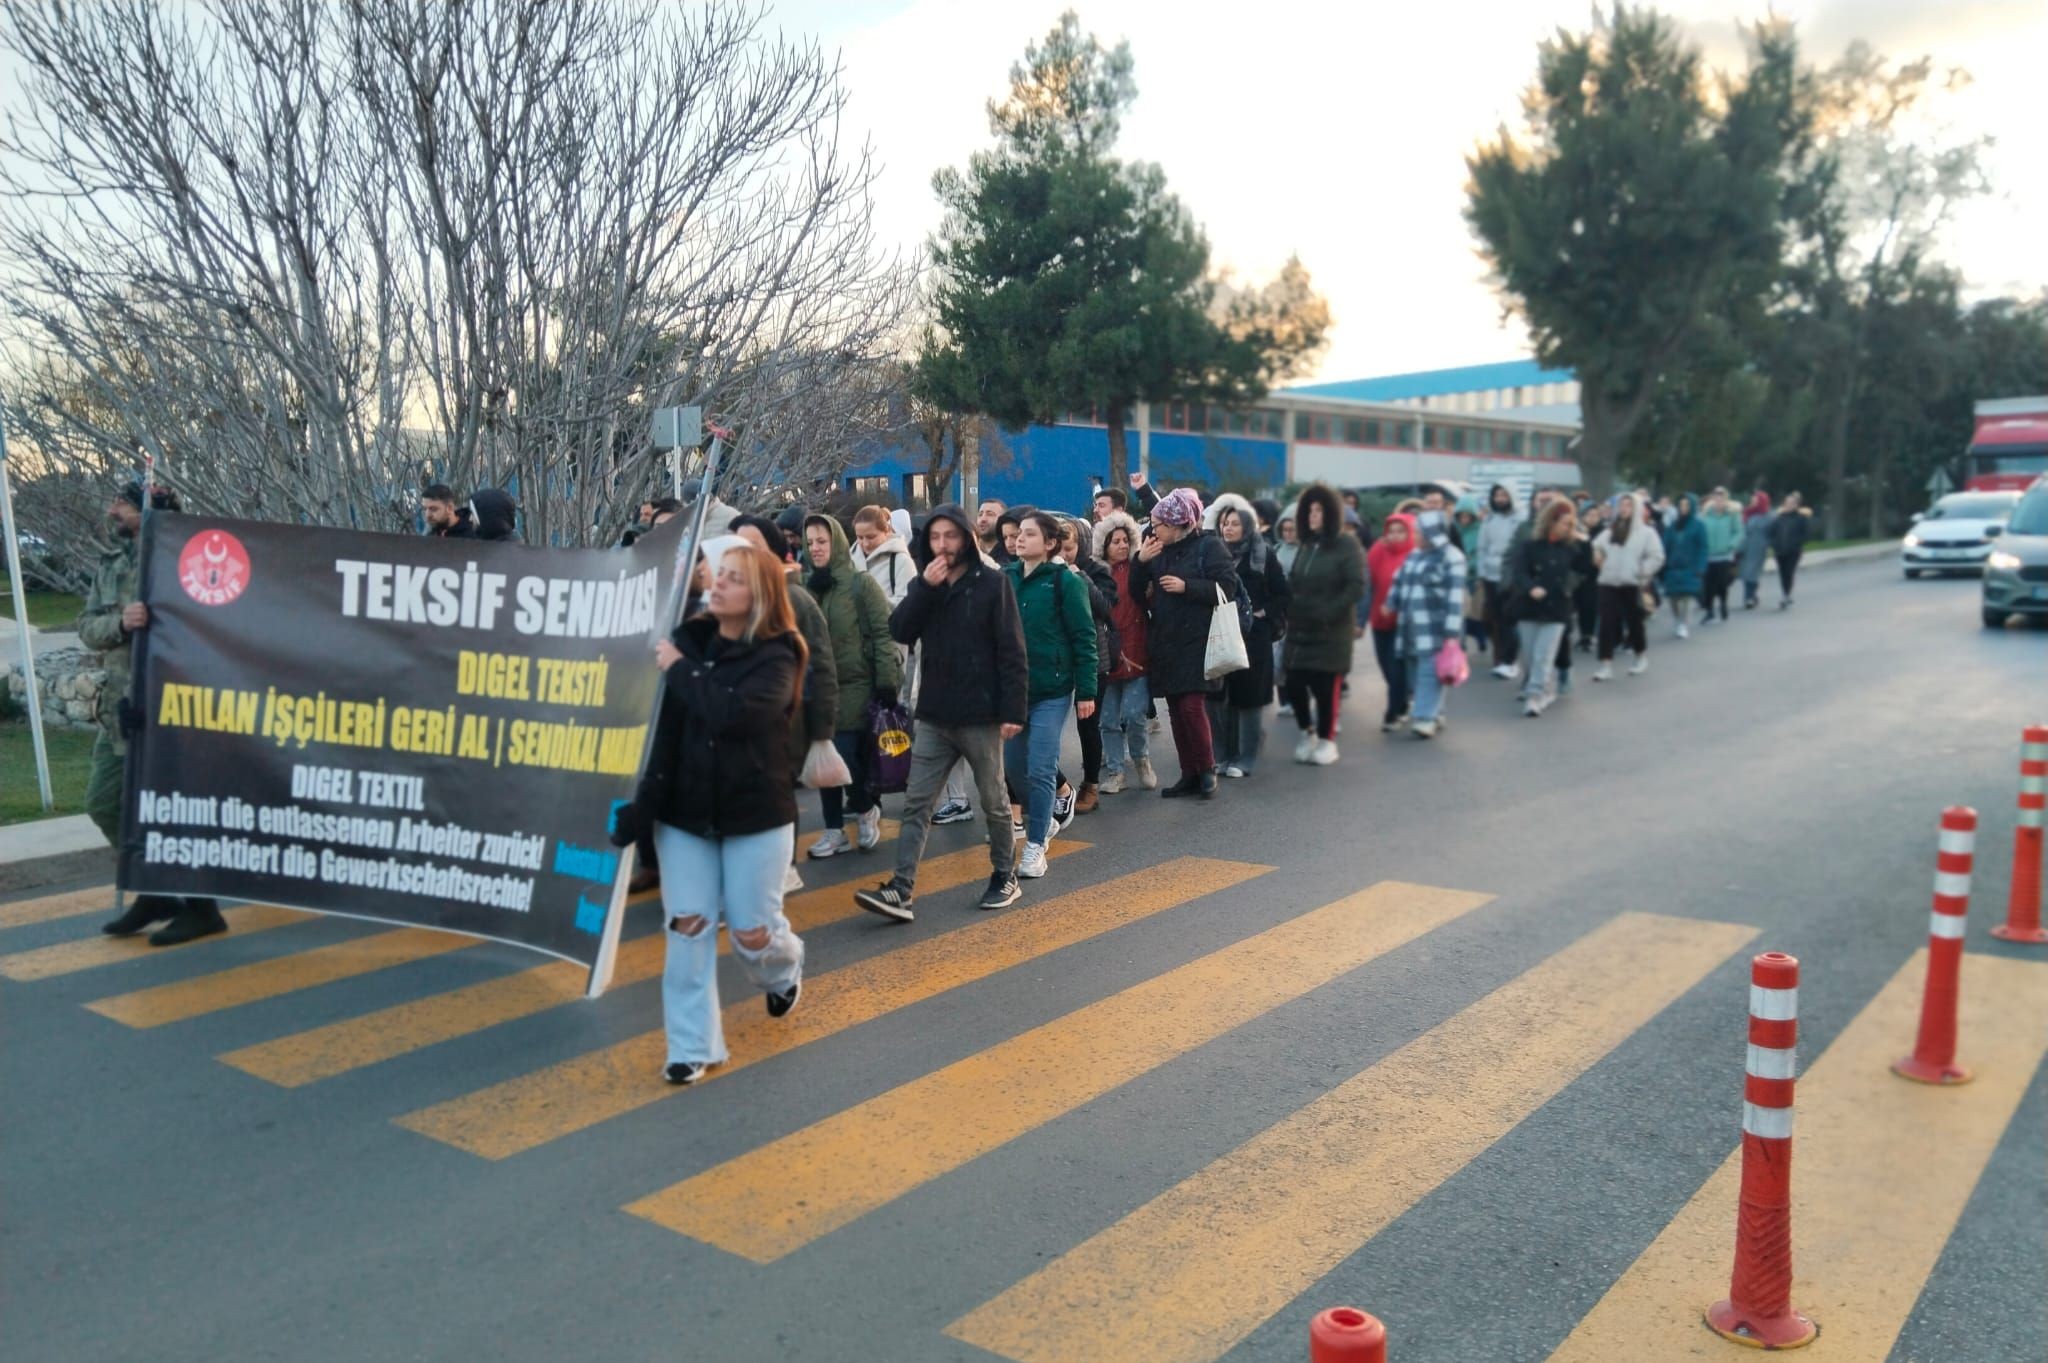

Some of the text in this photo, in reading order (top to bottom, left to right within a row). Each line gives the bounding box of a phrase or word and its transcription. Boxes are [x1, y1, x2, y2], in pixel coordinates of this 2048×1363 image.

[336, 559, 658, 639] TEKSİF SENDİKASI
[457, 650, 608, 707] DIGEL TEKSTİL
[159, 682, 257, 737] ATILAN
[262, 685, 384, 749] İŞÇİLERİ
[391, 705, 456, 758] GERİ
[457, 714, 489, 760] AL
[508, 717, 600, 773] SENDİKAL
[291, 764, 425, 811] DIGEL TEXTIL
[138, 790, 218, 828] Nehmt
[220, 797, 255, 831] die
[258, 803, 393, 850] entlassenen
[396, 815, 480, 859] Arbeiter
[480, 833, 546, 871] zurück!
[145, 831, 281, 876] Respektiert
[281, 841, 318, 880] die
[320, 850, 534, 913] Gewerkschaftsrechte!
